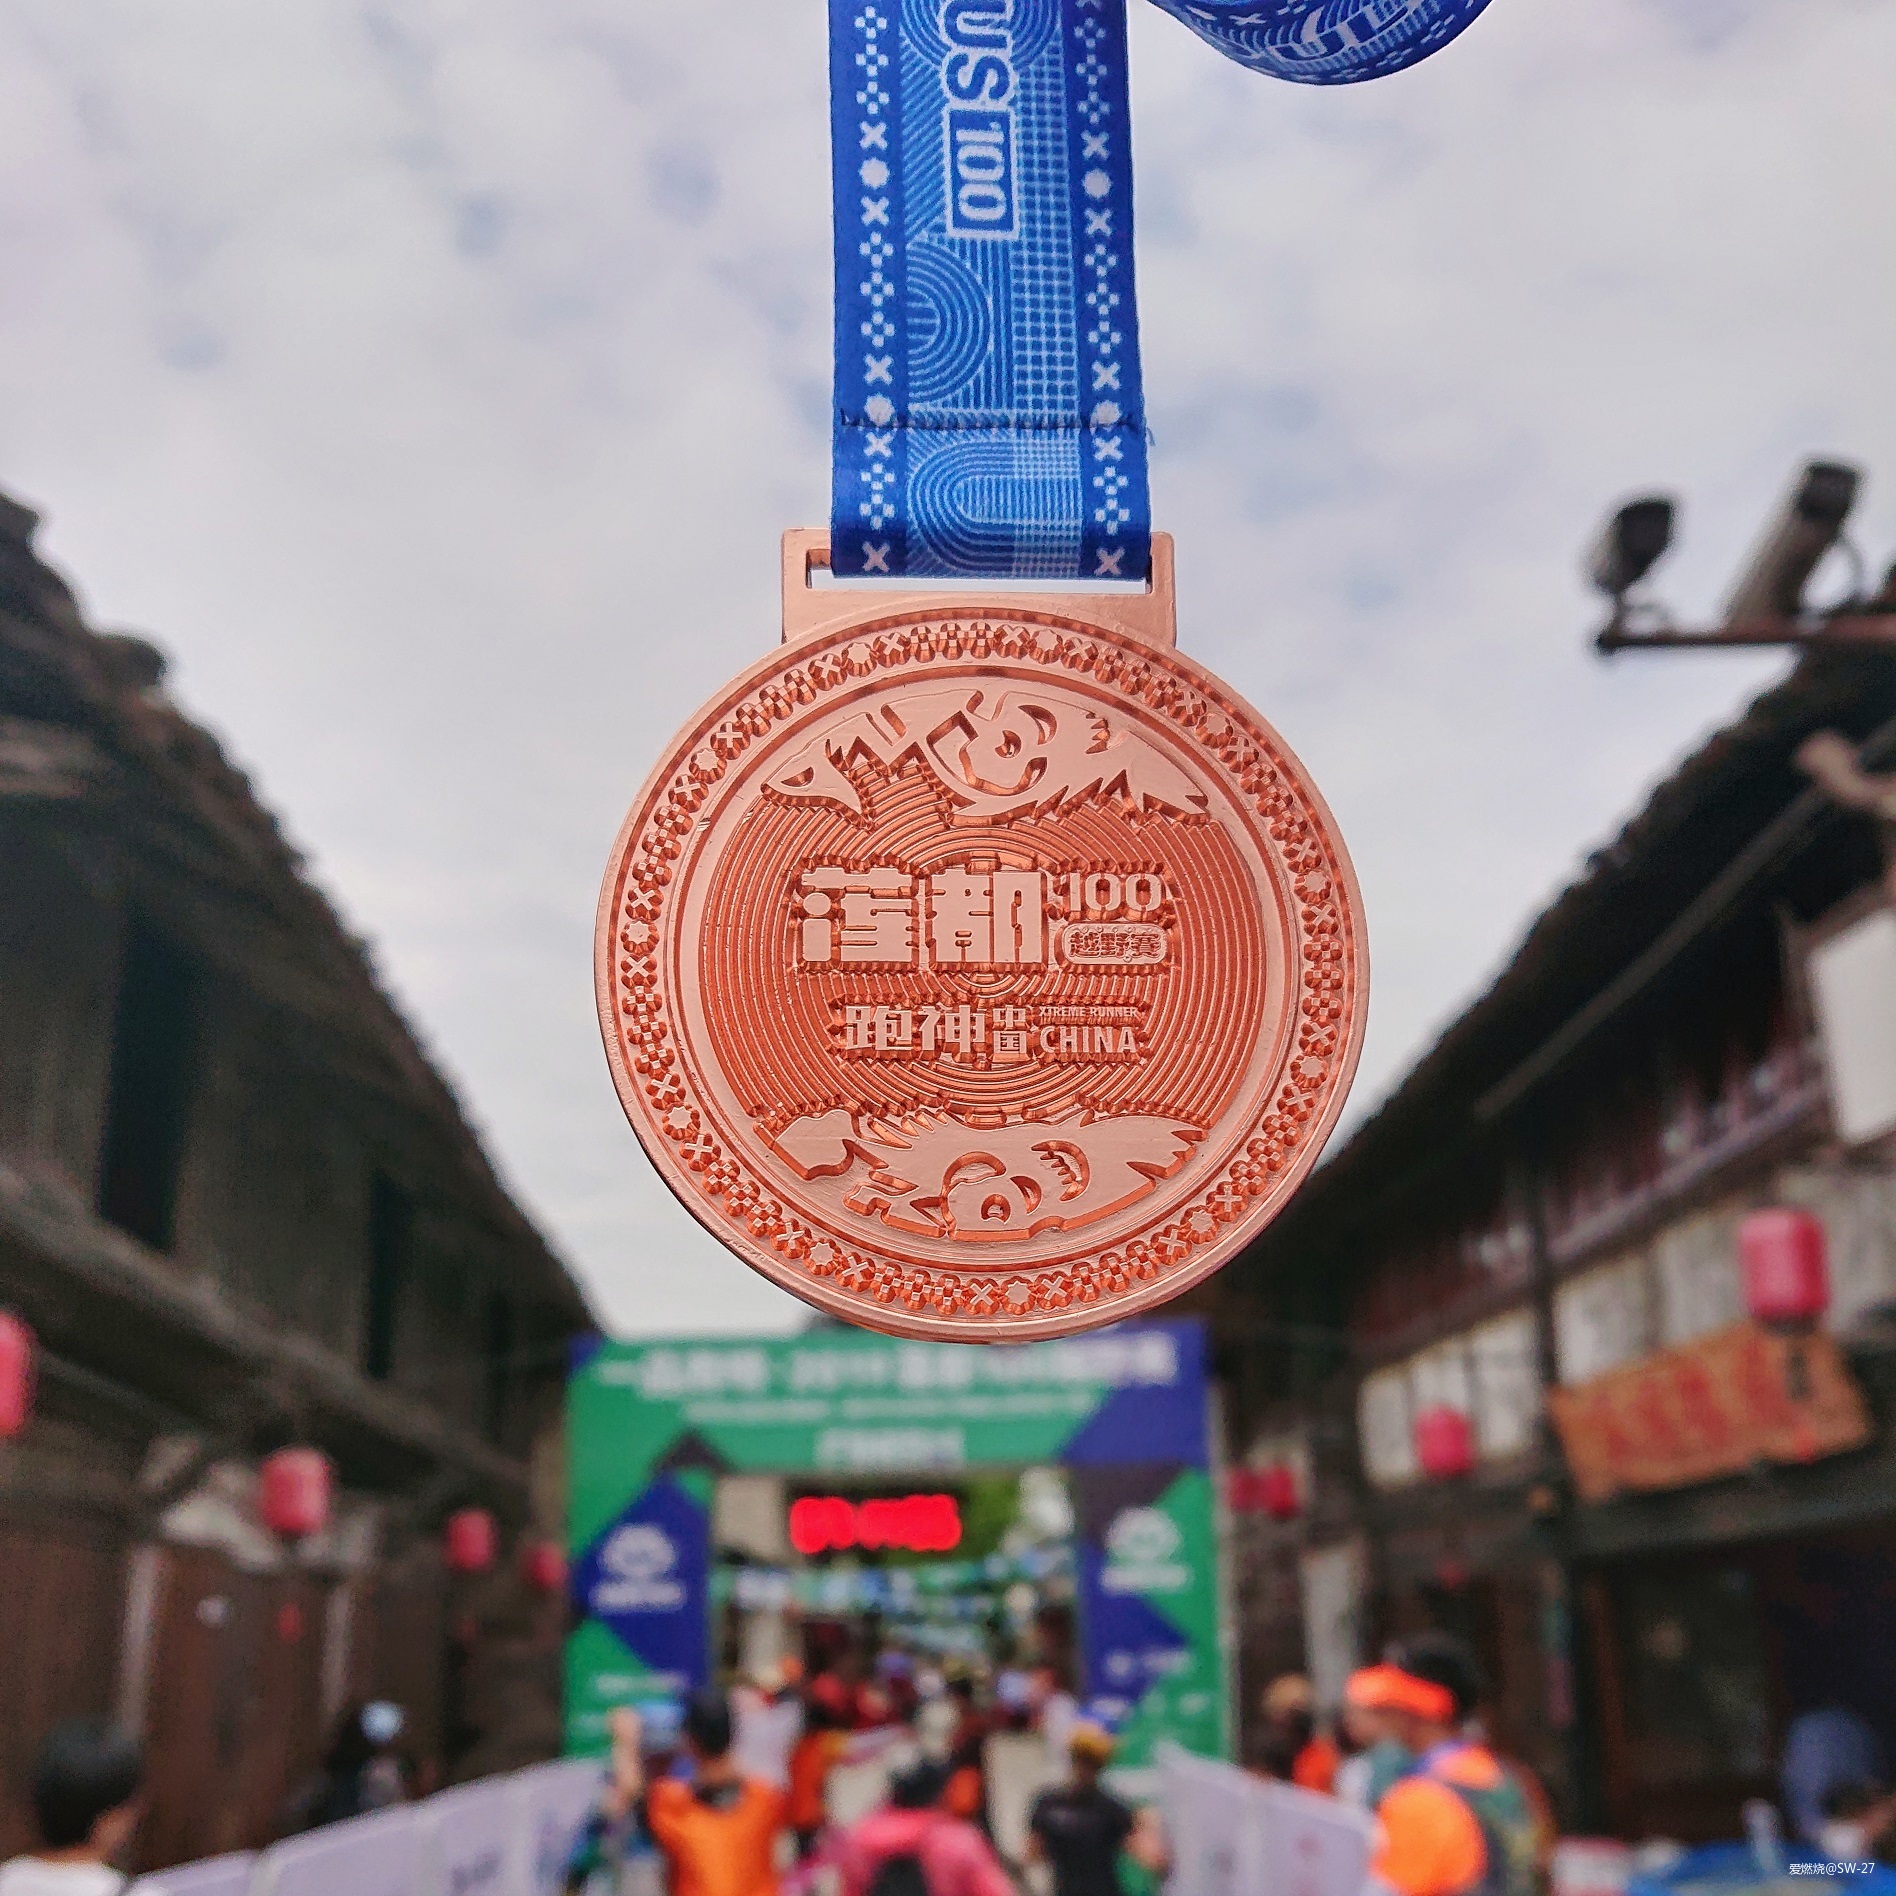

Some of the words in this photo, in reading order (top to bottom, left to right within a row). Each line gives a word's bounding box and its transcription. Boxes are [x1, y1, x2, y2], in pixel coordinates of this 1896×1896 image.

[956, 121, 1008, 221] 100
[1060, 872, 1163, 912] 100
[1069, 931, 1161, 957] 越野赛
[1039, 1006, 1086, 1018] XTREME
[1089, 1006, 1139, 1018] RUNNER
[1040, 1026, 1139, 1054] CHINA
